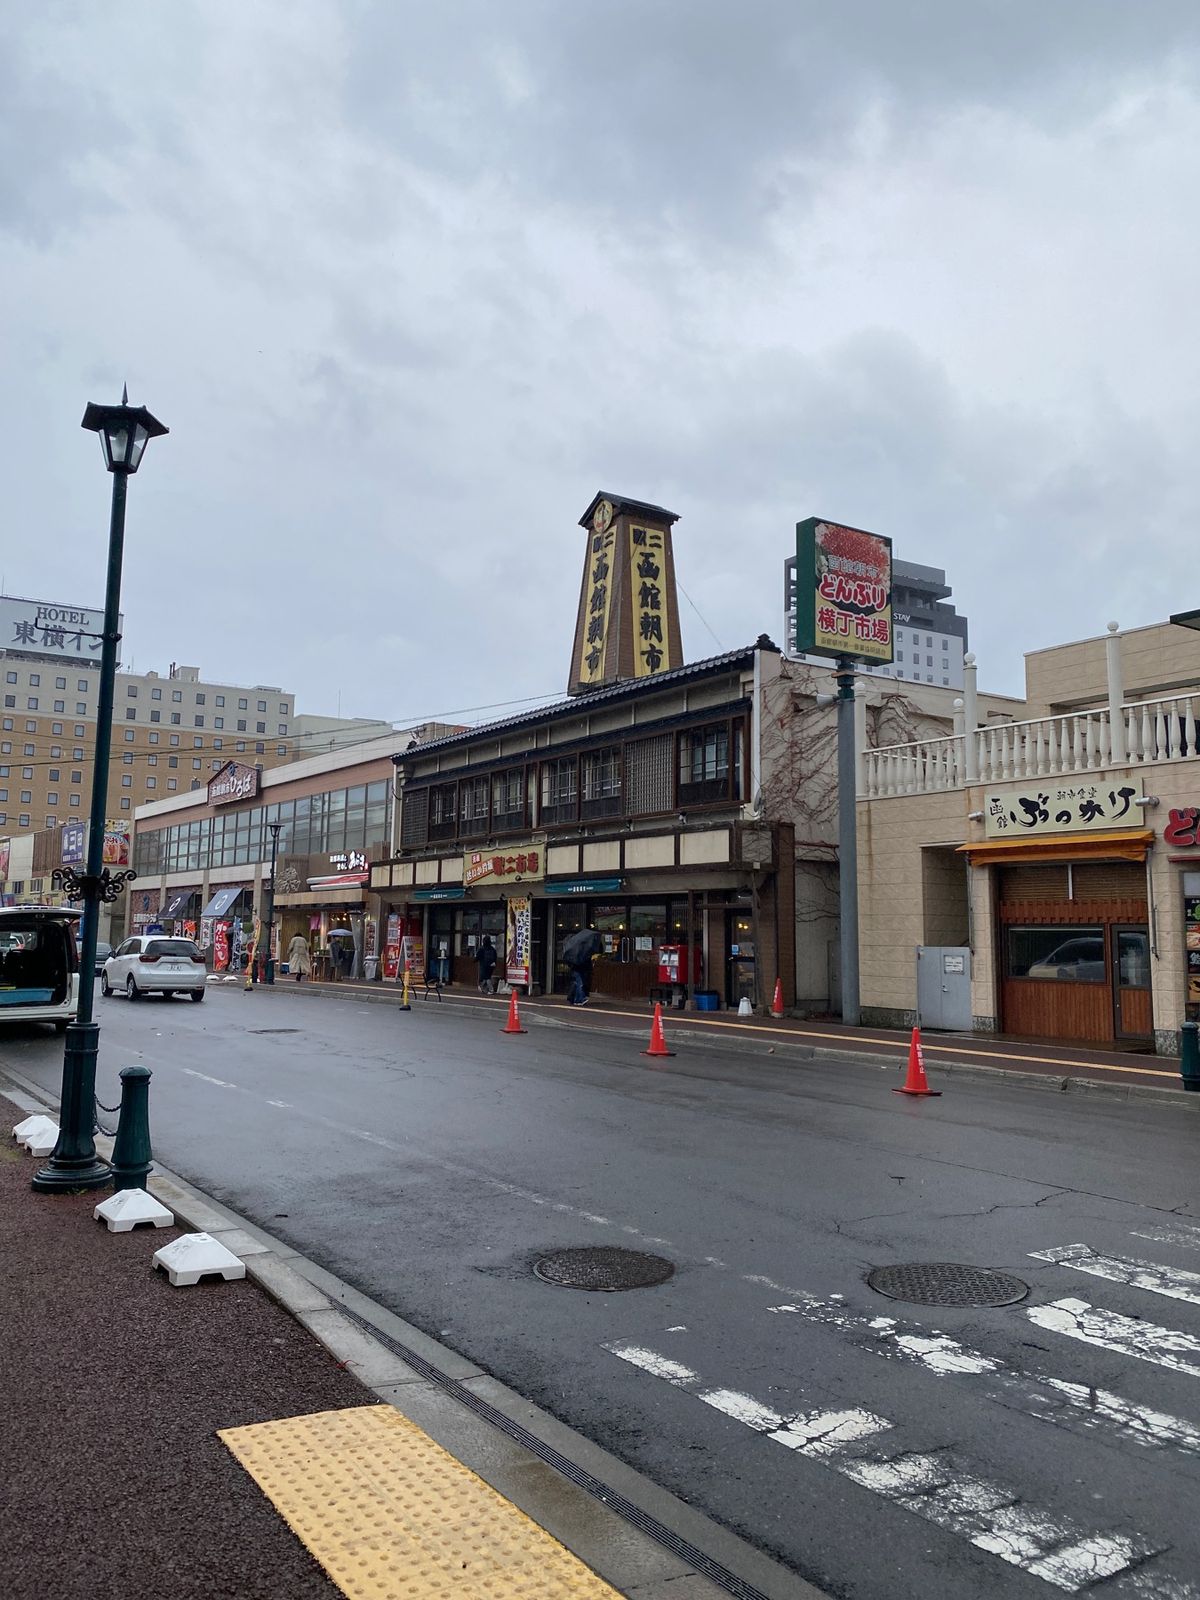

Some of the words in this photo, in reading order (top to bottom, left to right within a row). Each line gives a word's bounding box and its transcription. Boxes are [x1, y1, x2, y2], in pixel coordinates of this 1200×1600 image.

[819, 573, 886, 610] どんぶり
[37, 606, 89, 626] HOTEL
[585, 552, 610, 676] 函館朝市
[637, 551, 664, 673] 函館朝市
[816, 606, 890, 644] 横丁市場
[893, 612, 910, 623] STAY
[11, 620, 104, 651] 東横イン
[990, 798, 1008, 829] 函館
[1164, 806, 1200, 846] ど
